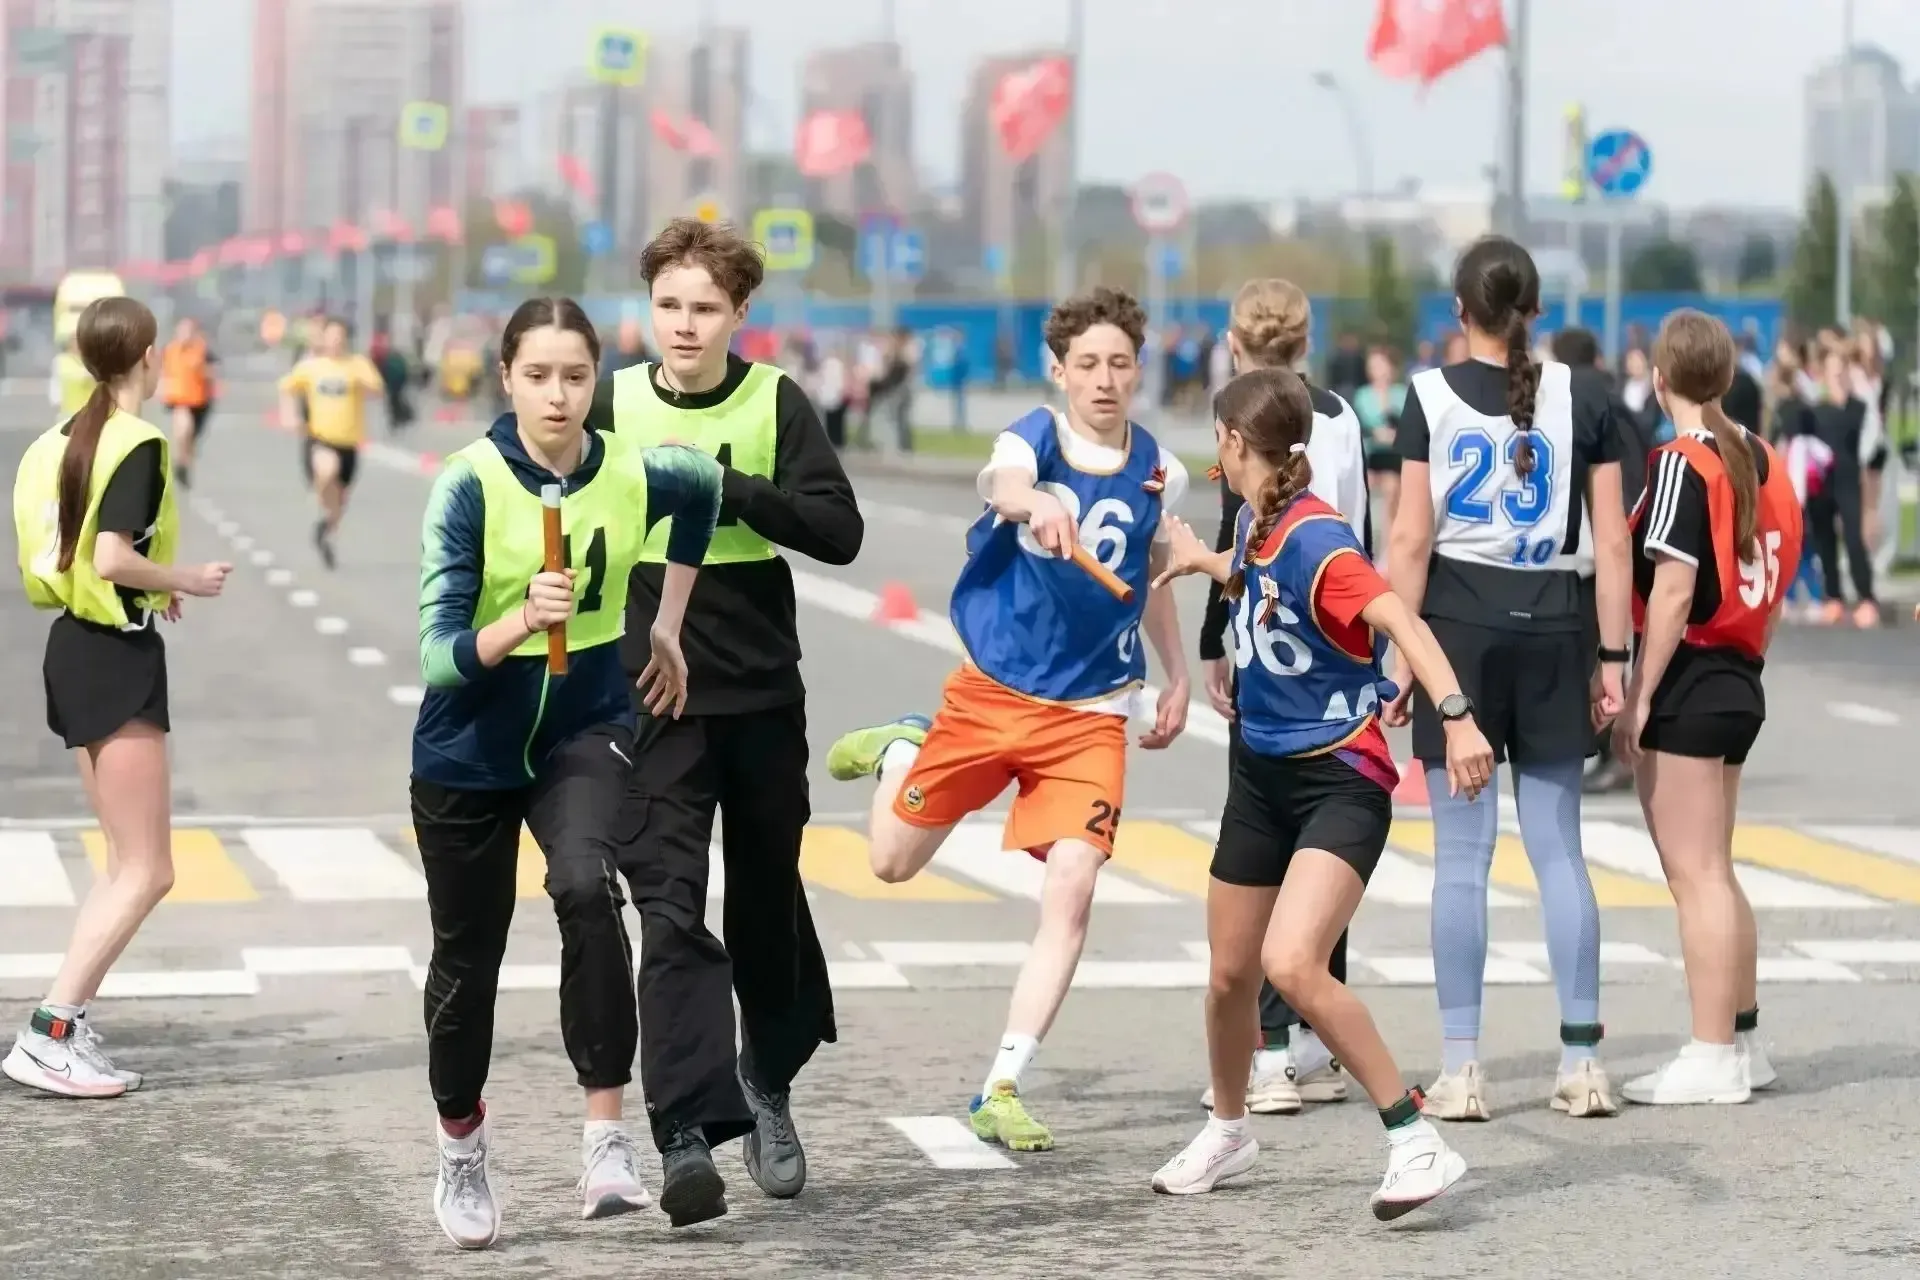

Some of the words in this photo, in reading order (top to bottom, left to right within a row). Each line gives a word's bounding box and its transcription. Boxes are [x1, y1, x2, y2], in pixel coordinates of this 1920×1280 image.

[1445, 427, 1554, 527] 23
[1506, 535, 1556, 566] 10
[1738, 530, 1781, 609] 95
